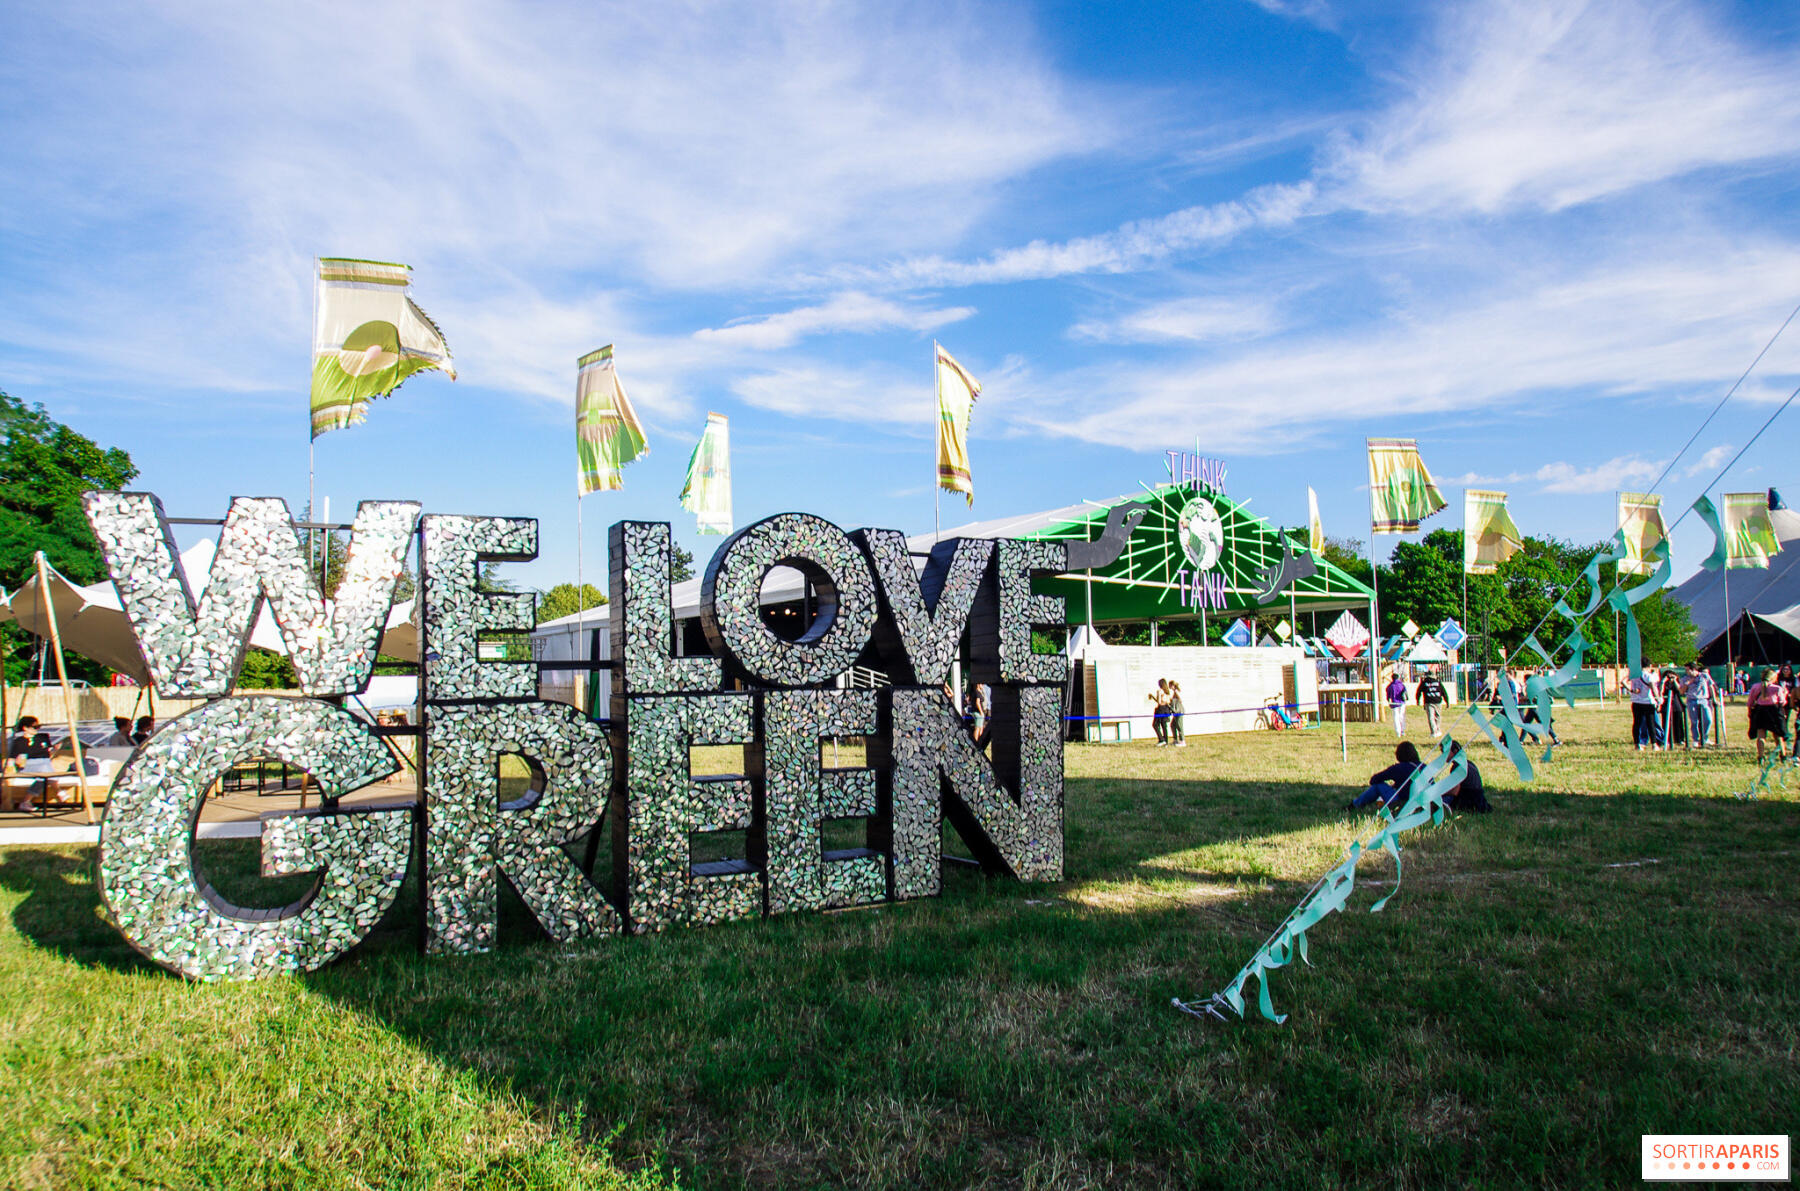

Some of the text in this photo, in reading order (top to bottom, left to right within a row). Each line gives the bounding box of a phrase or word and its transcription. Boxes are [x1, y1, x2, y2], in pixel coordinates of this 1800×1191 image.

[1166, 450, 1227, 496] THINK
[83, 491, 1067, 699] WE LOVE
[1176, 569, 1228, 609] TANK
[100, 695, 1065, 983] GREEN
